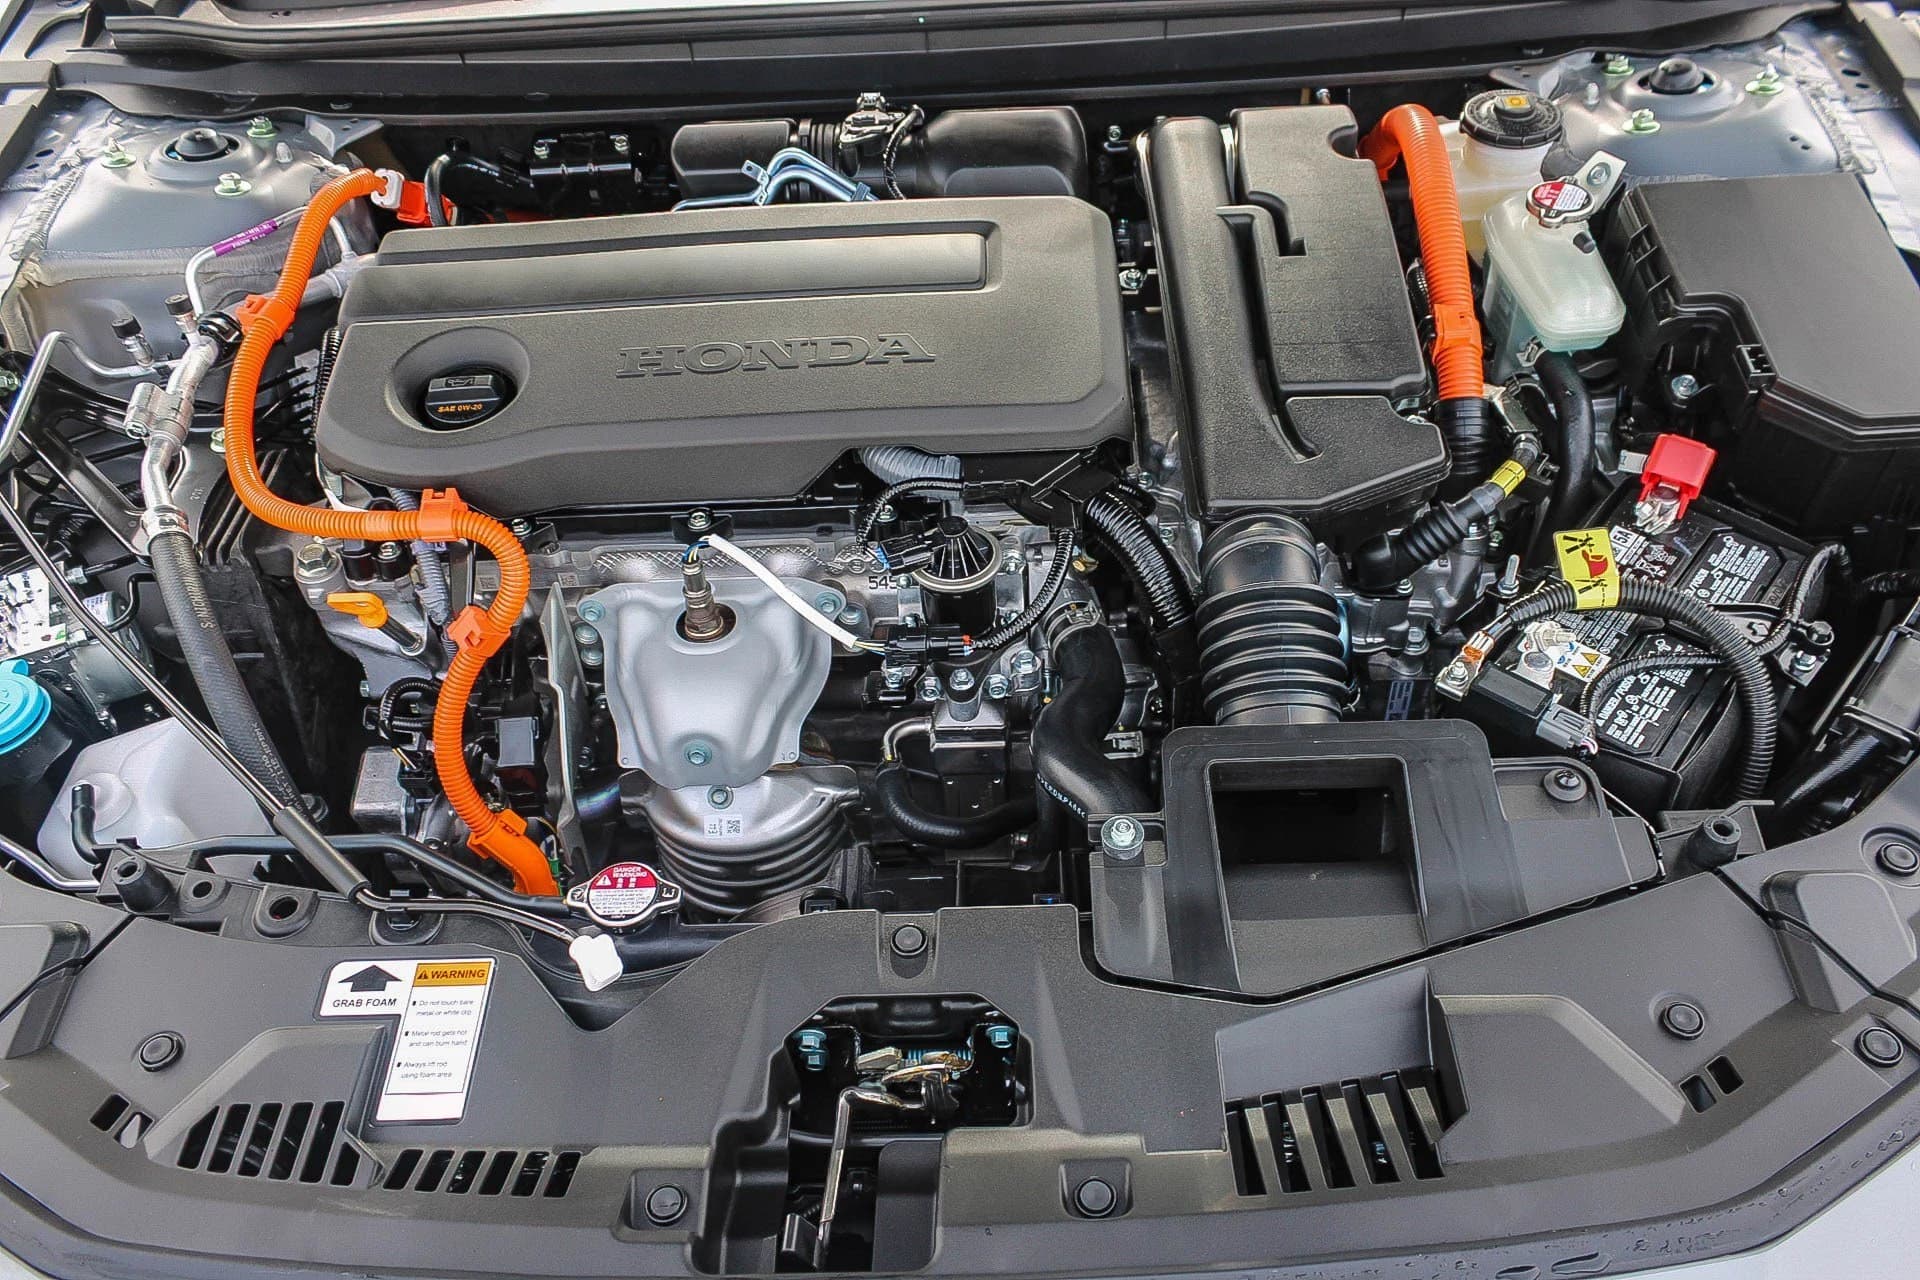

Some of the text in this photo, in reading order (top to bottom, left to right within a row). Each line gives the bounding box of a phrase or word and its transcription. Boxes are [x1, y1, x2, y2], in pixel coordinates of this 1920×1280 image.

[615, 333, 936, 378] HONDA
[438, 403, 484, 413] SAE 0W-20
[430, 968, 486, 980] WARNING
[332, 997, 398, 1008] GRAB FOAM
[441, 1030, 456, 1038] gets
[403, 1061, 427, 1069] Always
[420, 1071, 436, 1079] foam
